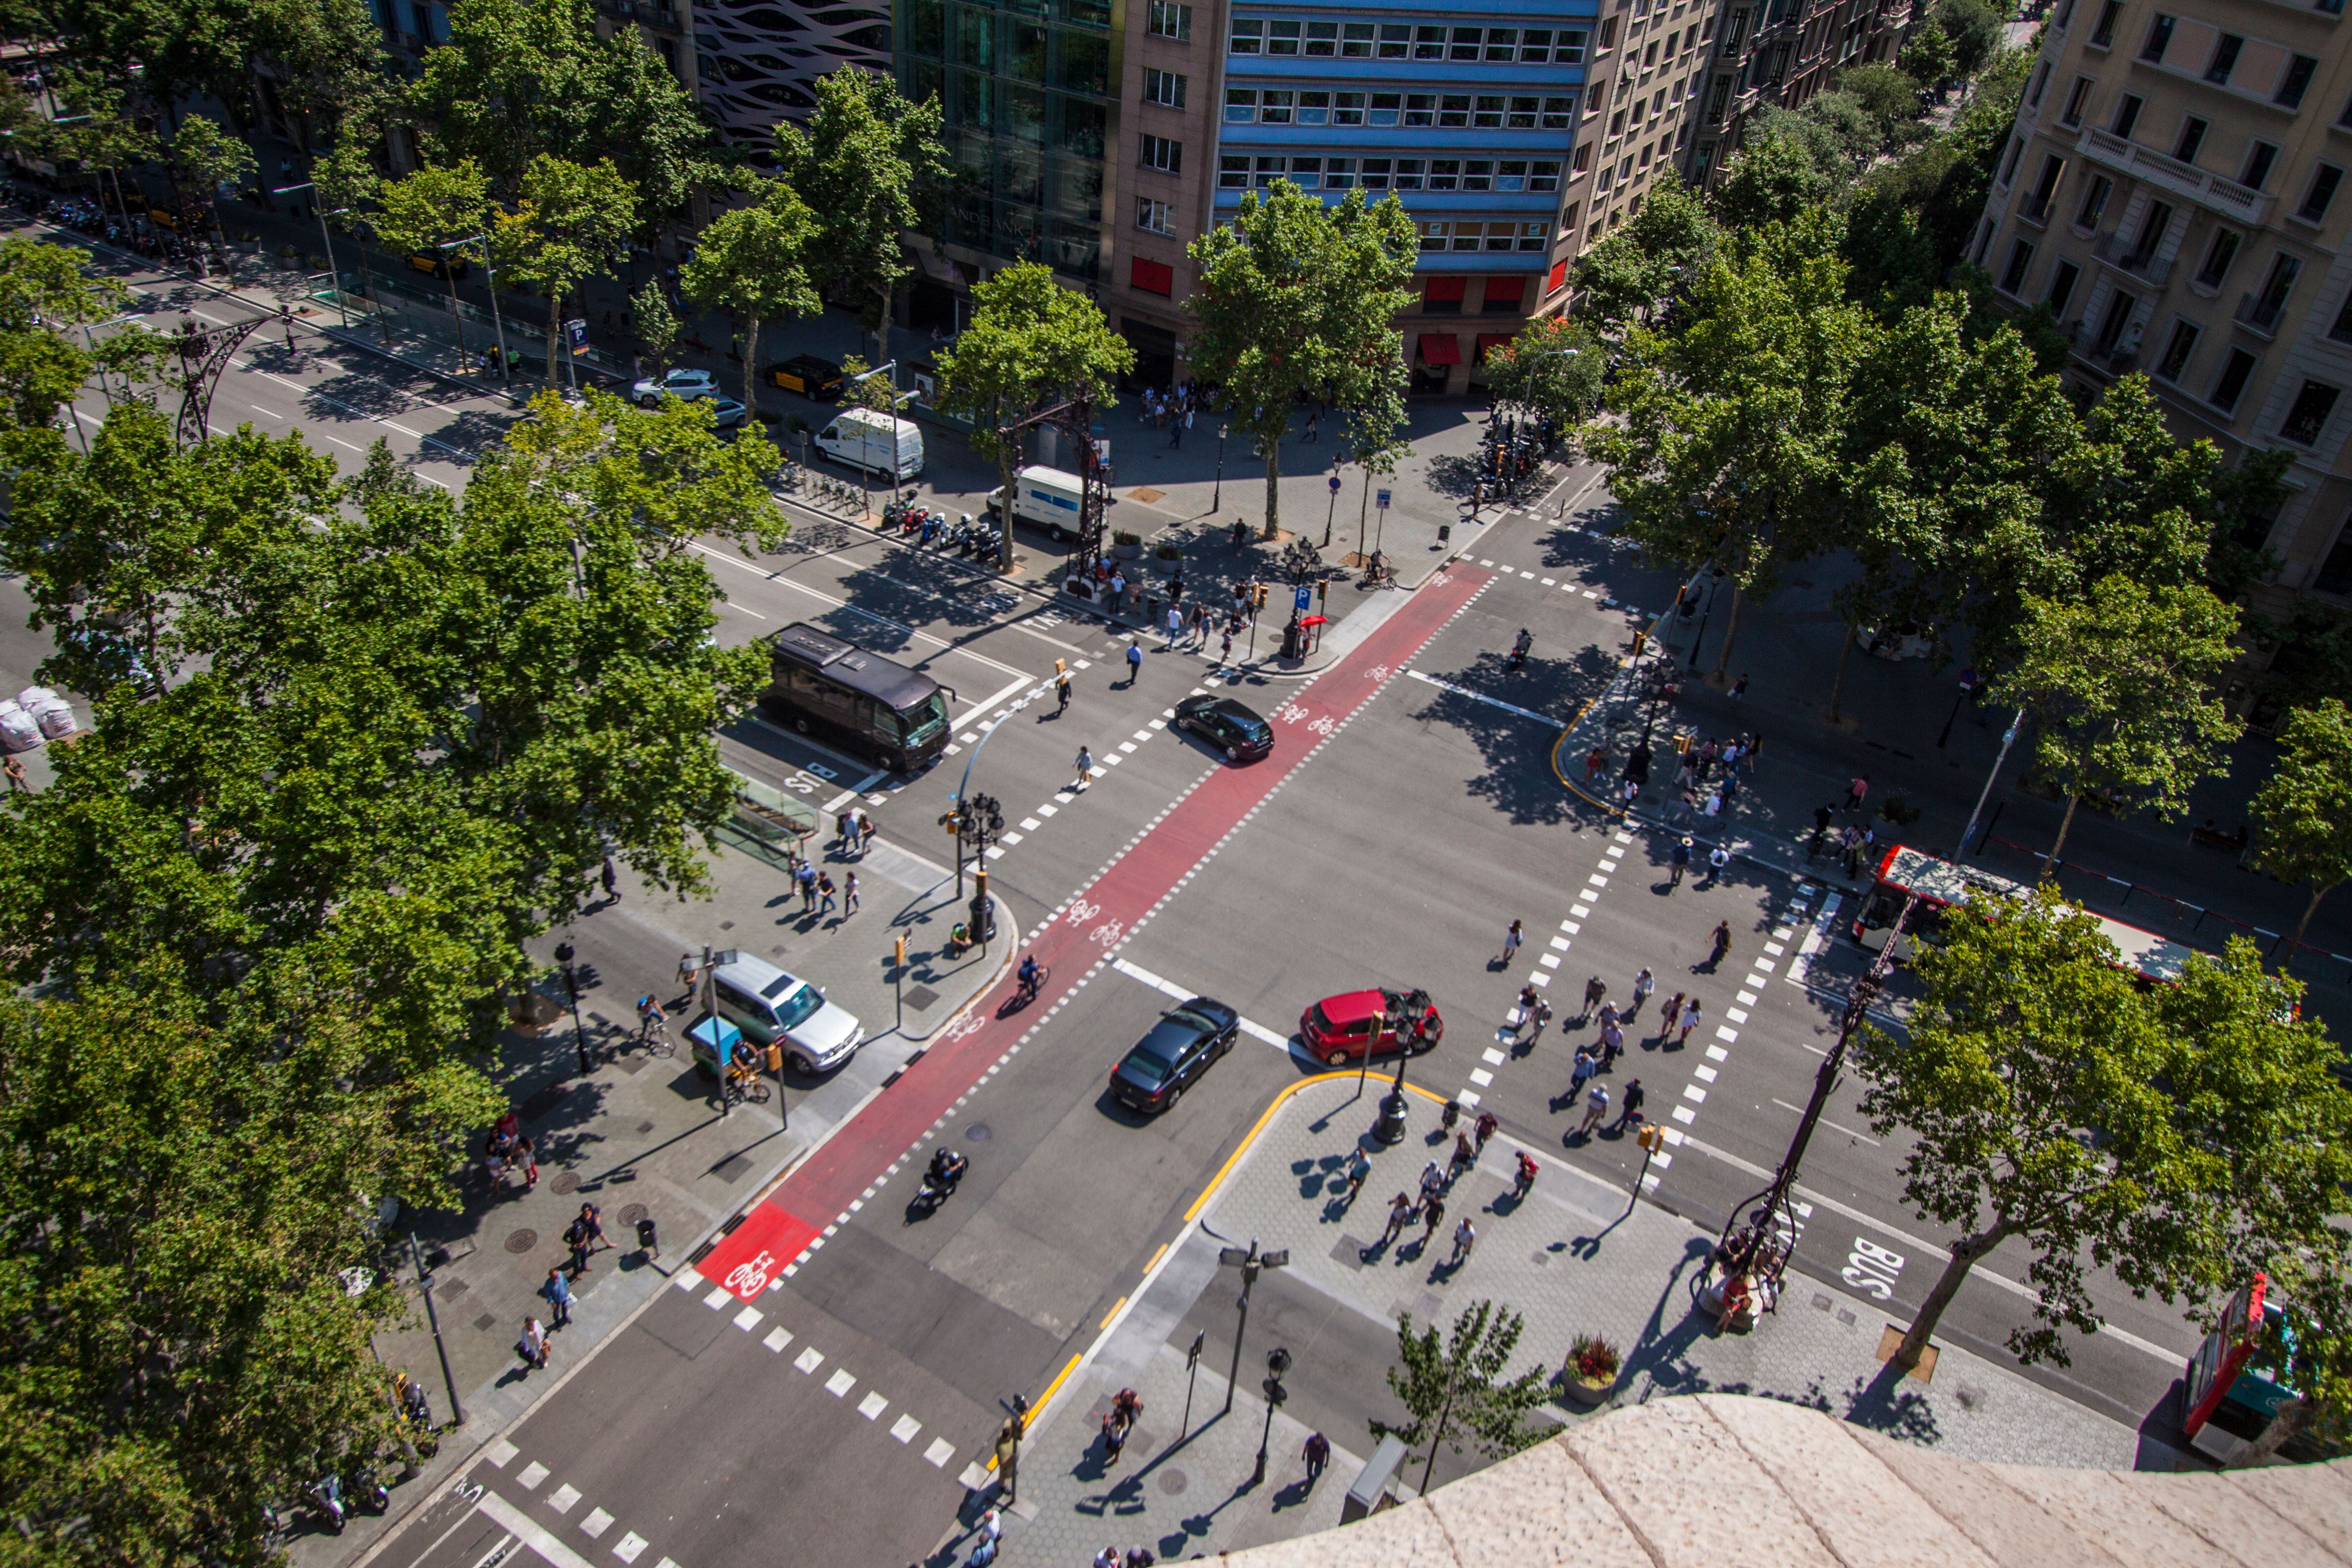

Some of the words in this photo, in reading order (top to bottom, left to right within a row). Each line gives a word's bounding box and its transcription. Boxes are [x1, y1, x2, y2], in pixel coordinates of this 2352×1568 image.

[576, 329, 583, 341] P
[980, 588, 1024, 611] BUS
[1298, 588, 1308, 600] P
[784, 762, 838, 794] BUS
[1841, 1236, 1905, 1300] BUS
